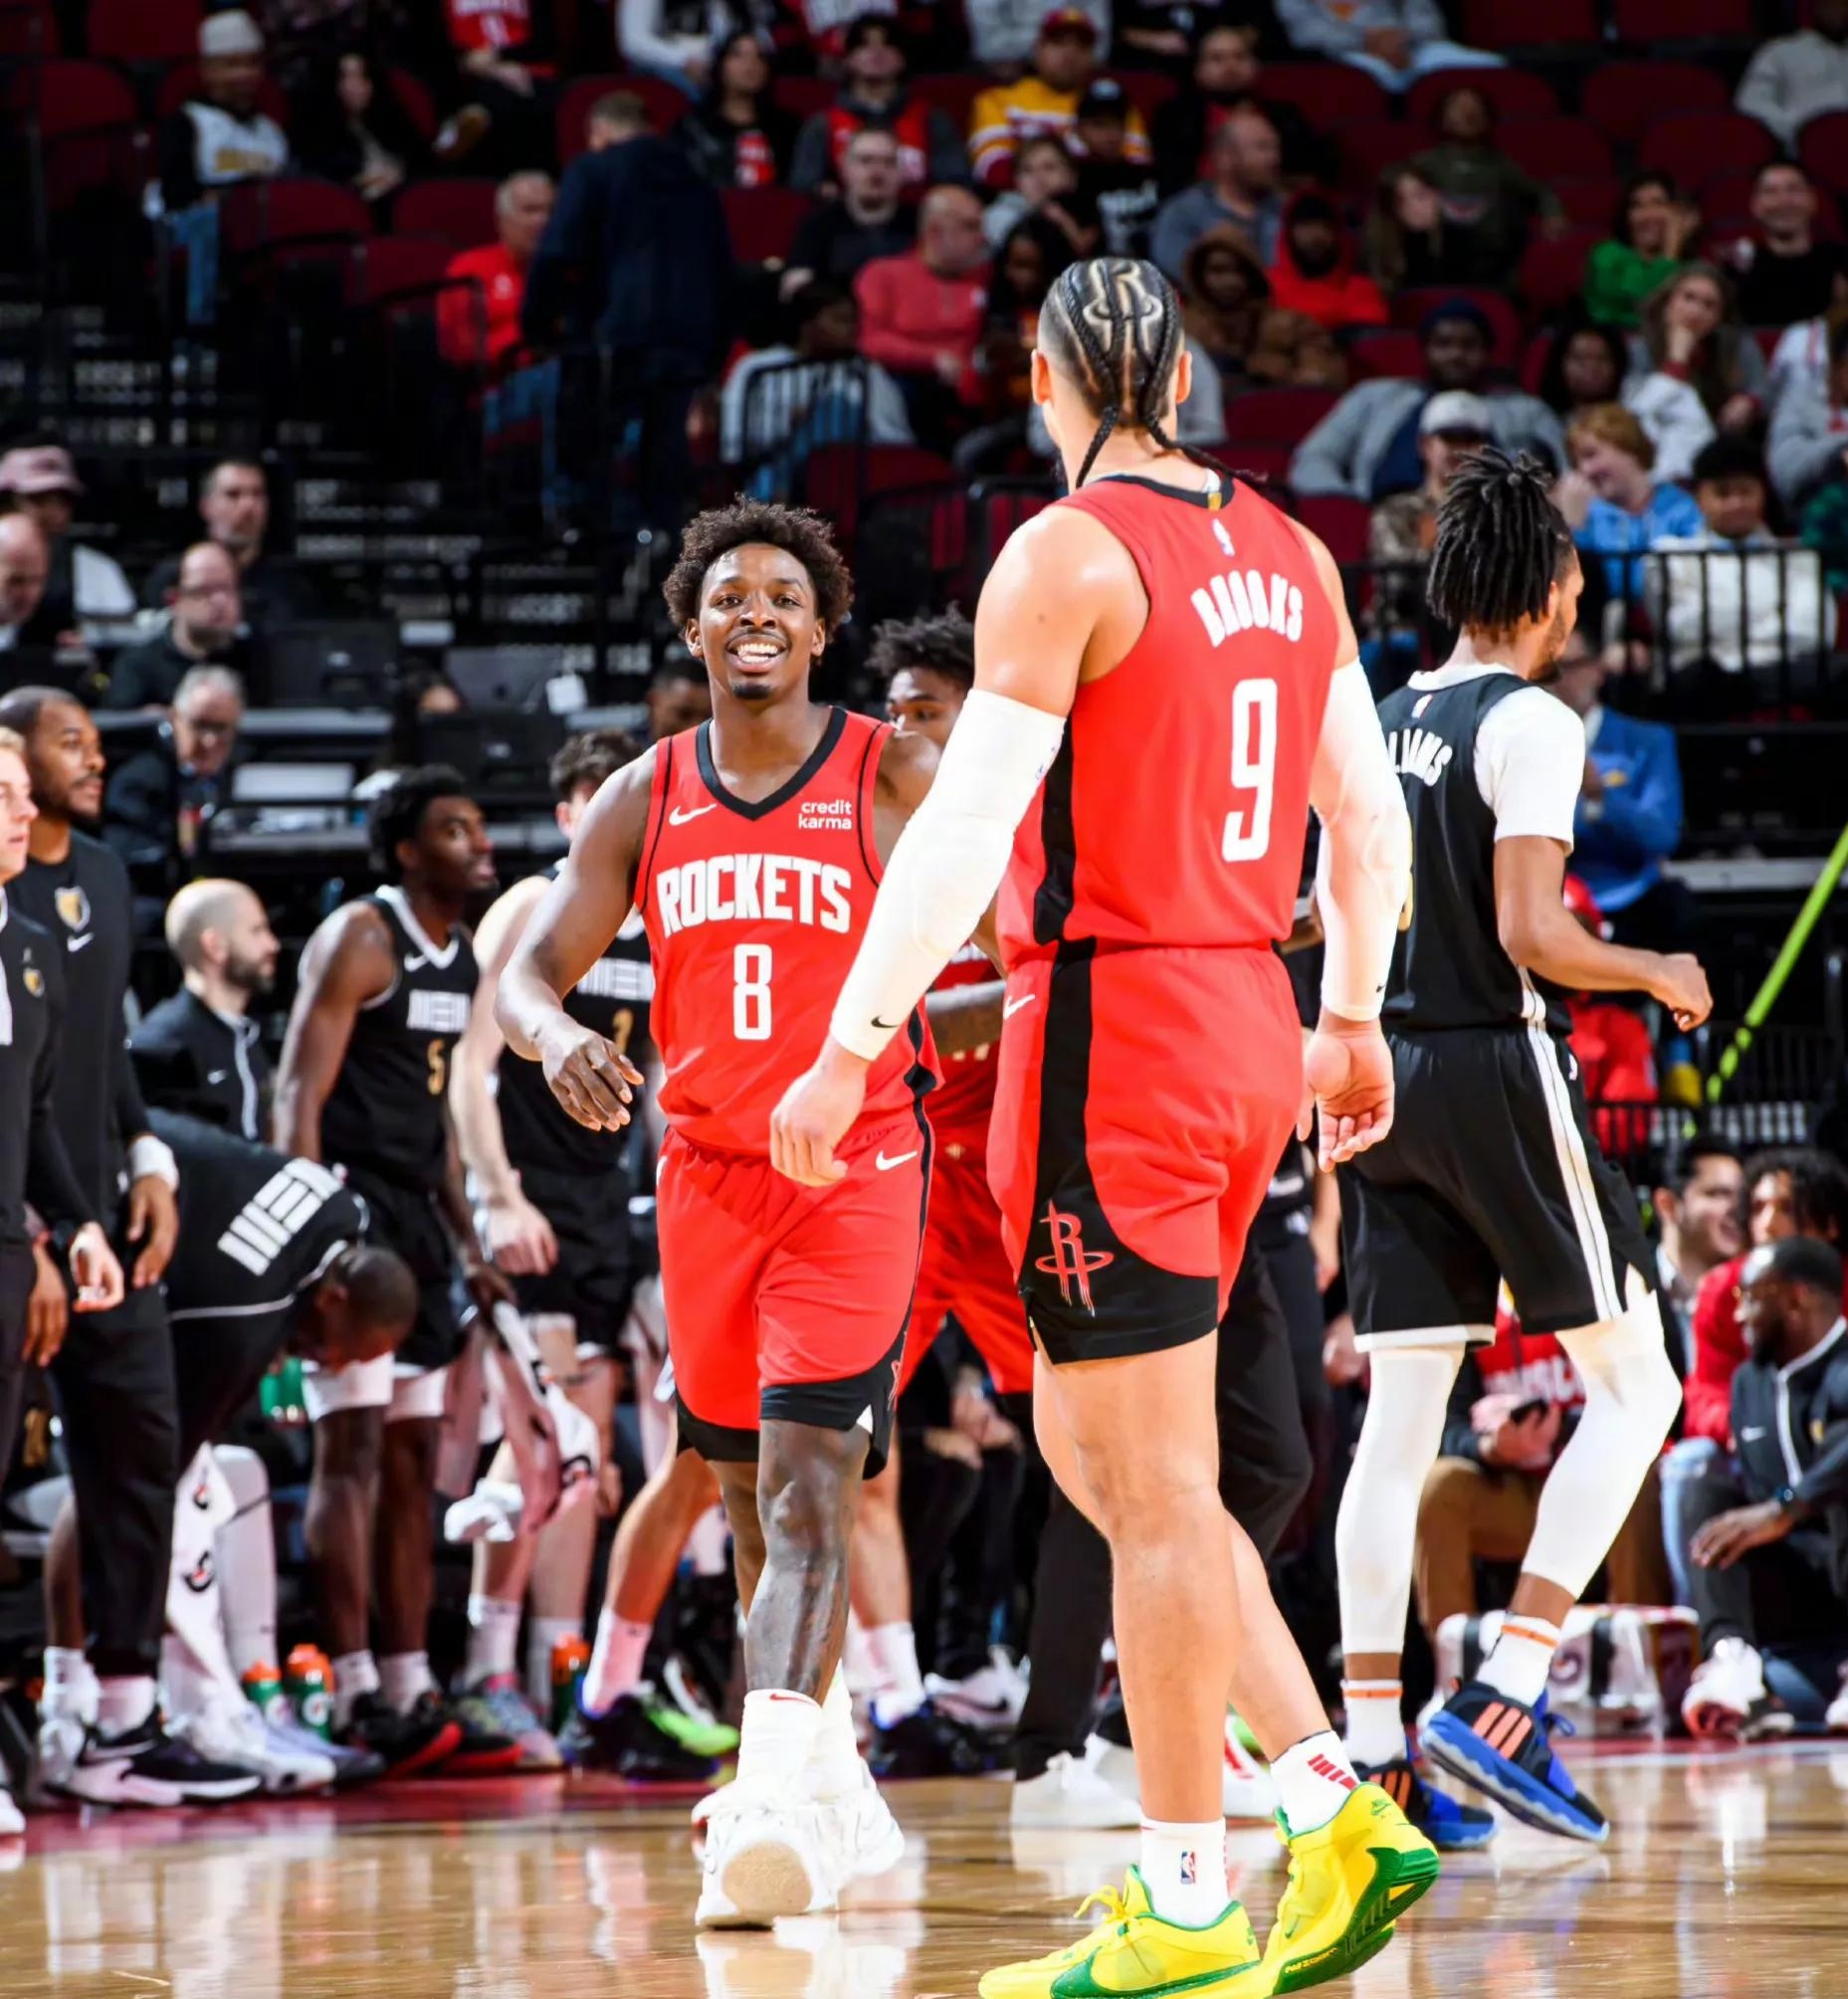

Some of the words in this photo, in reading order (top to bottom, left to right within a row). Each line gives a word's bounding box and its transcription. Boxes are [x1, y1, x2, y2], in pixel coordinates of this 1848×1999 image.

[1190, 570, 1303, 647] BROOKS
[801, 800, 852, 815] credit
[1222, 678, 1278, 862] 9
[798, 815, 853, 831] karma
[656, 853, 852, 939] ROCKETS
[733, 943, 773, 1041] 8
[428, 1039, 445, 1095] 5
